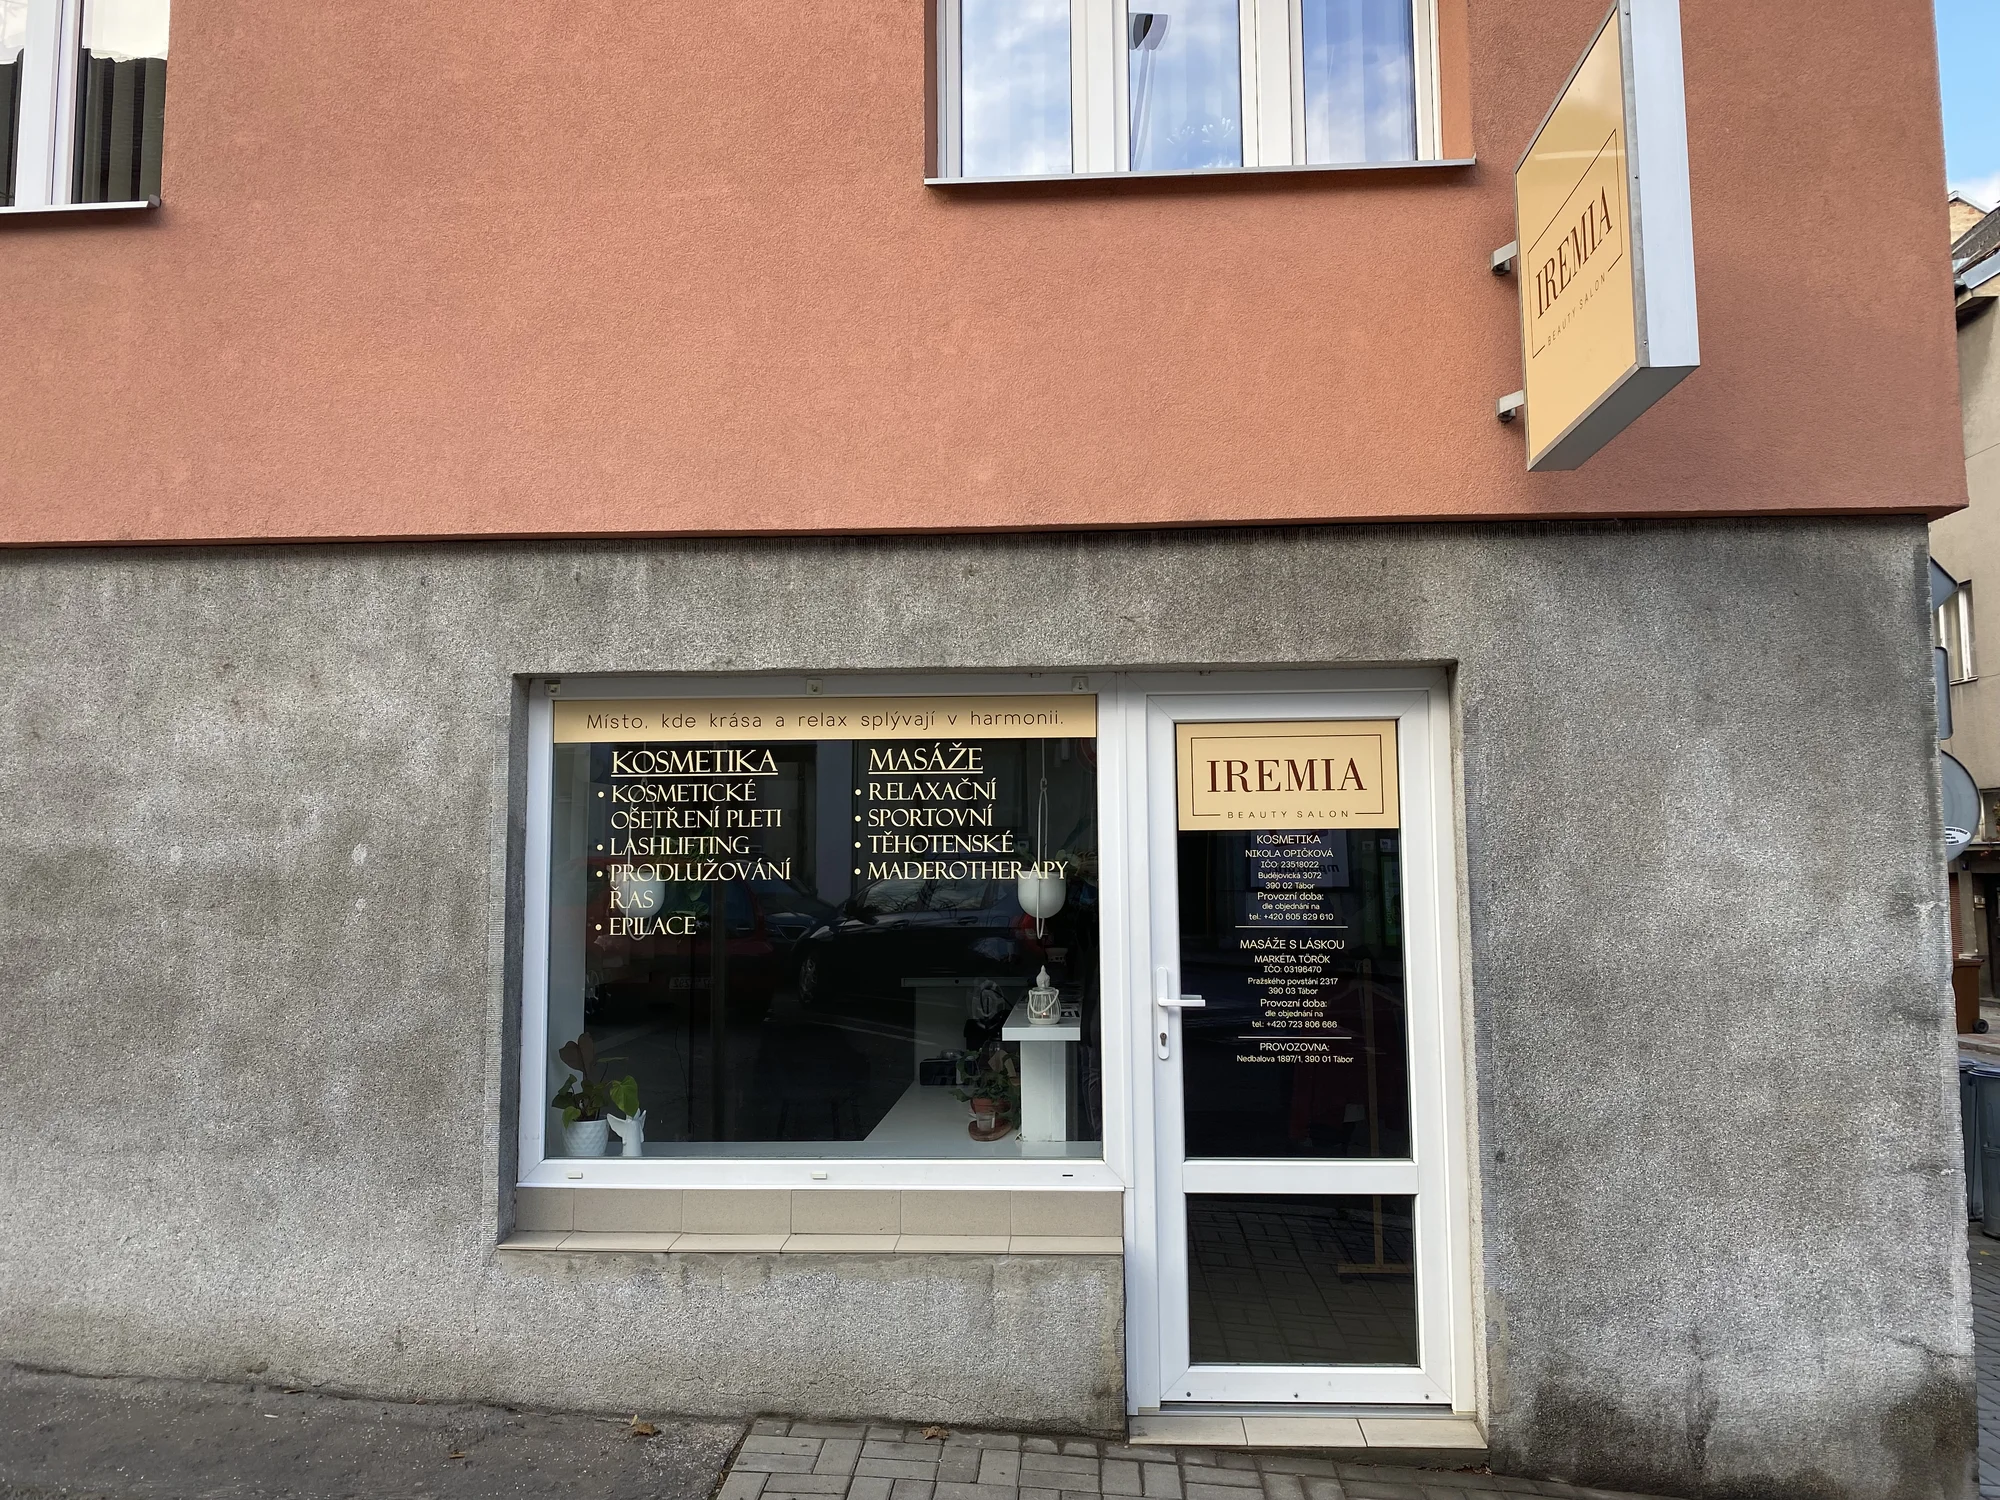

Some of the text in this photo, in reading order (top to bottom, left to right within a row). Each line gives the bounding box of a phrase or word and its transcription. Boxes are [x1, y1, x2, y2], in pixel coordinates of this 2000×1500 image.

[1535, 187, 1613, 319] IREMIA
[1547, 272, 1607, 346] BEAUTY SALON
[660, 711, 696, 728] kde
[708, 711, 761, 727] krása
[776, 716, 784, 727] a
[796, 710, 848, 727] relax
[860, 709, 936, 730] splývají
[948, 715, 957, 725] v
[969, 709, 1063, 725] harmonii.
[612, 749, 778, 773] KOSMETIKA
[869, 743, 983, 770] MASÁŽE
[1207, 758, 1367, 792] IREMIA
[612, 779, 756, 802] KOSMETICKÉ
[869, 778, 996, 800] RELAXAČNÍ
[611, 806, 781, 829] OŠETŘENÍ PLETI
[868, 804, 992, 826] SPORTOVNÍ
[611, 835, 749, 856] LASHLIFTING
[868, 830, 1014, 853] TĚHOTENSKÉ
[1257, 835, 1321, 844] KOSMETIKA
[1283, 848, 1333, 857] OPIČKOVÁ
[610, 857, 790, 883] PRODLUŽOVÁNÍ
[868, 859, 1068, 881] MADEROTHERAPY
[1258, 872, 1300, 880] Budějovická
[611, 886, 653, 908] ŘAS
[1258, 892, 1323, 900] Provozní doba:
[1275, 903, 1309, 911] objednání
[610, 915, 696, 937] EPILACE
[1240, 937, 1344, 949] MASÁŽE S LÁSKOU
[1255, 953, 1330, 963] MARKÉTA TÖRÖK
[1264, 964, 1282, 973] IČO:
[1287, 978, 1318, 986] povstání
[1261, 999, 1327, 1007] Provozní doba:
[1278, 1010, 1313, 1018] objednání
[1260, 1043, 1329, 1051] PROVOZOVNA:
